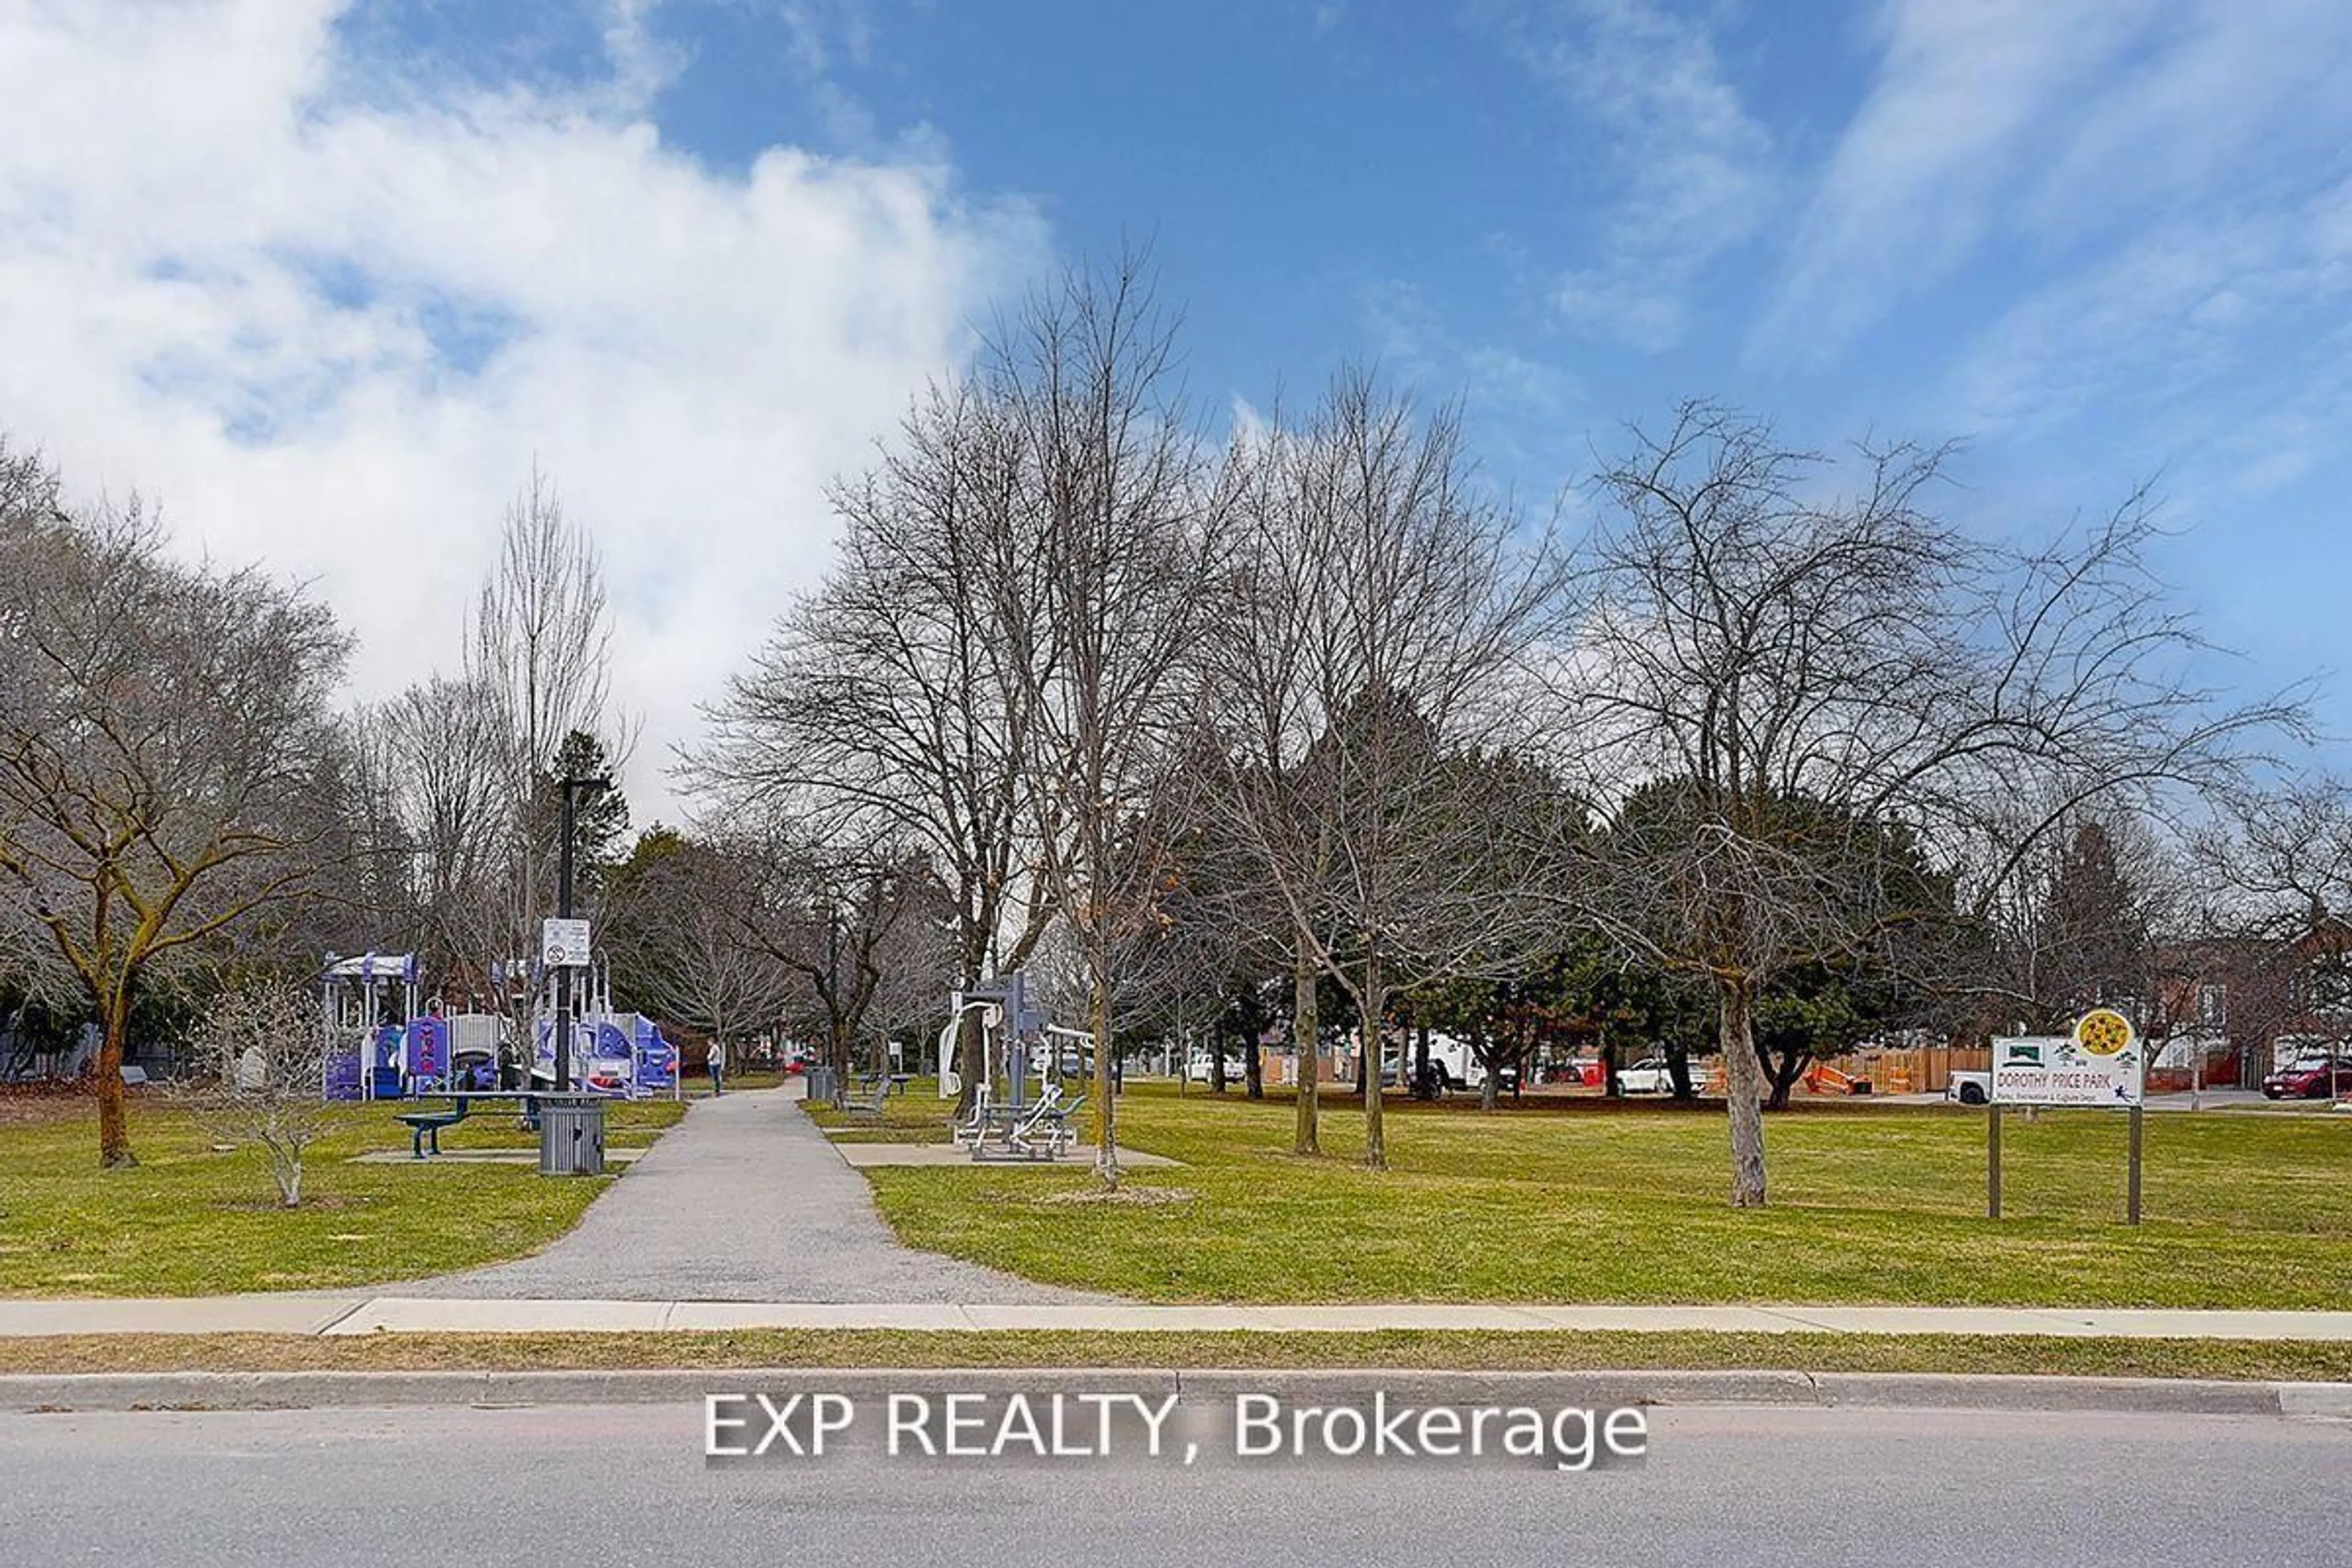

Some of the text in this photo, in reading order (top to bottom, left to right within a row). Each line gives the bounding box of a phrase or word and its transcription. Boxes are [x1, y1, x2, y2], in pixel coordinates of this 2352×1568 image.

[1997, 1072, 2111, 1088] DOROTHY PRICE PARK
